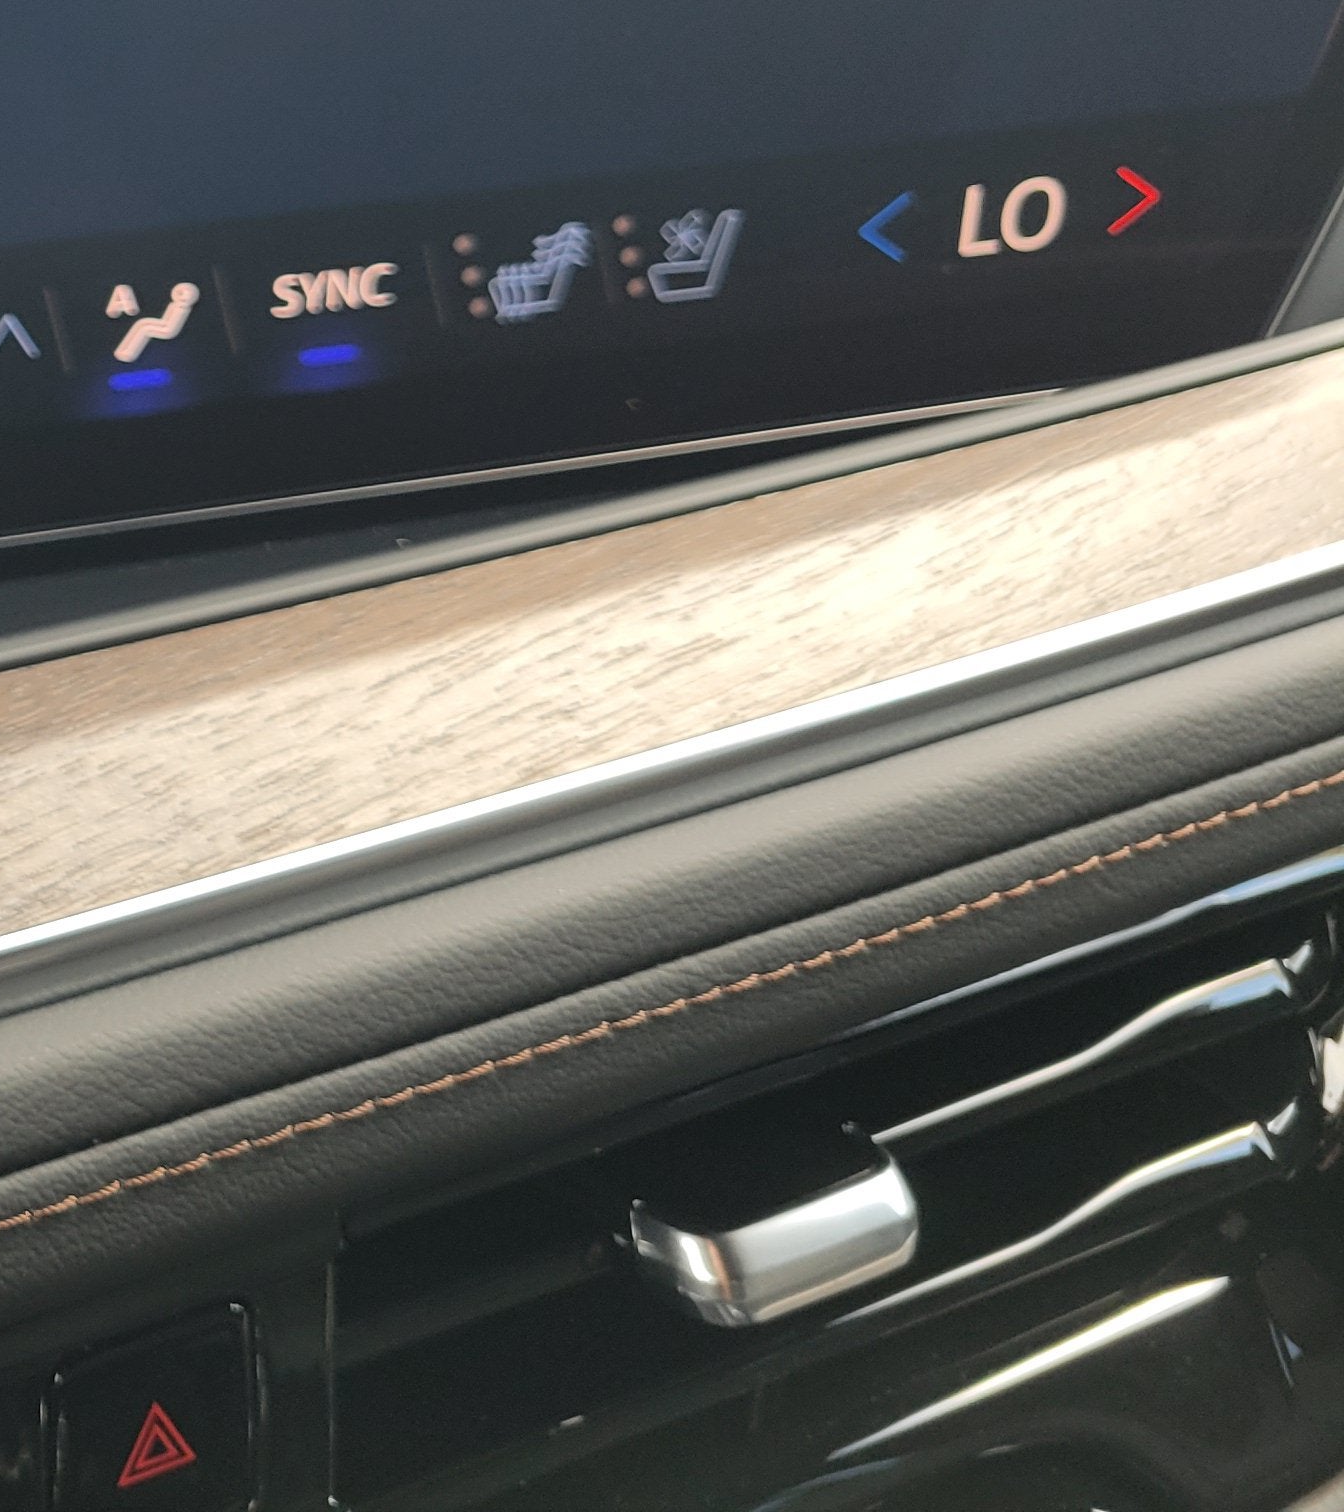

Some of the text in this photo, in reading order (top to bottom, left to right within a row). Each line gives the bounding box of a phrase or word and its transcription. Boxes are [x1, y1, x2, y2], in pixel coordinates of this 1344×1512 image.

[957, 176, 1066, 258] LO
[105, 284, 140, 319] A
[269, 262, 399, 319] SYNC
